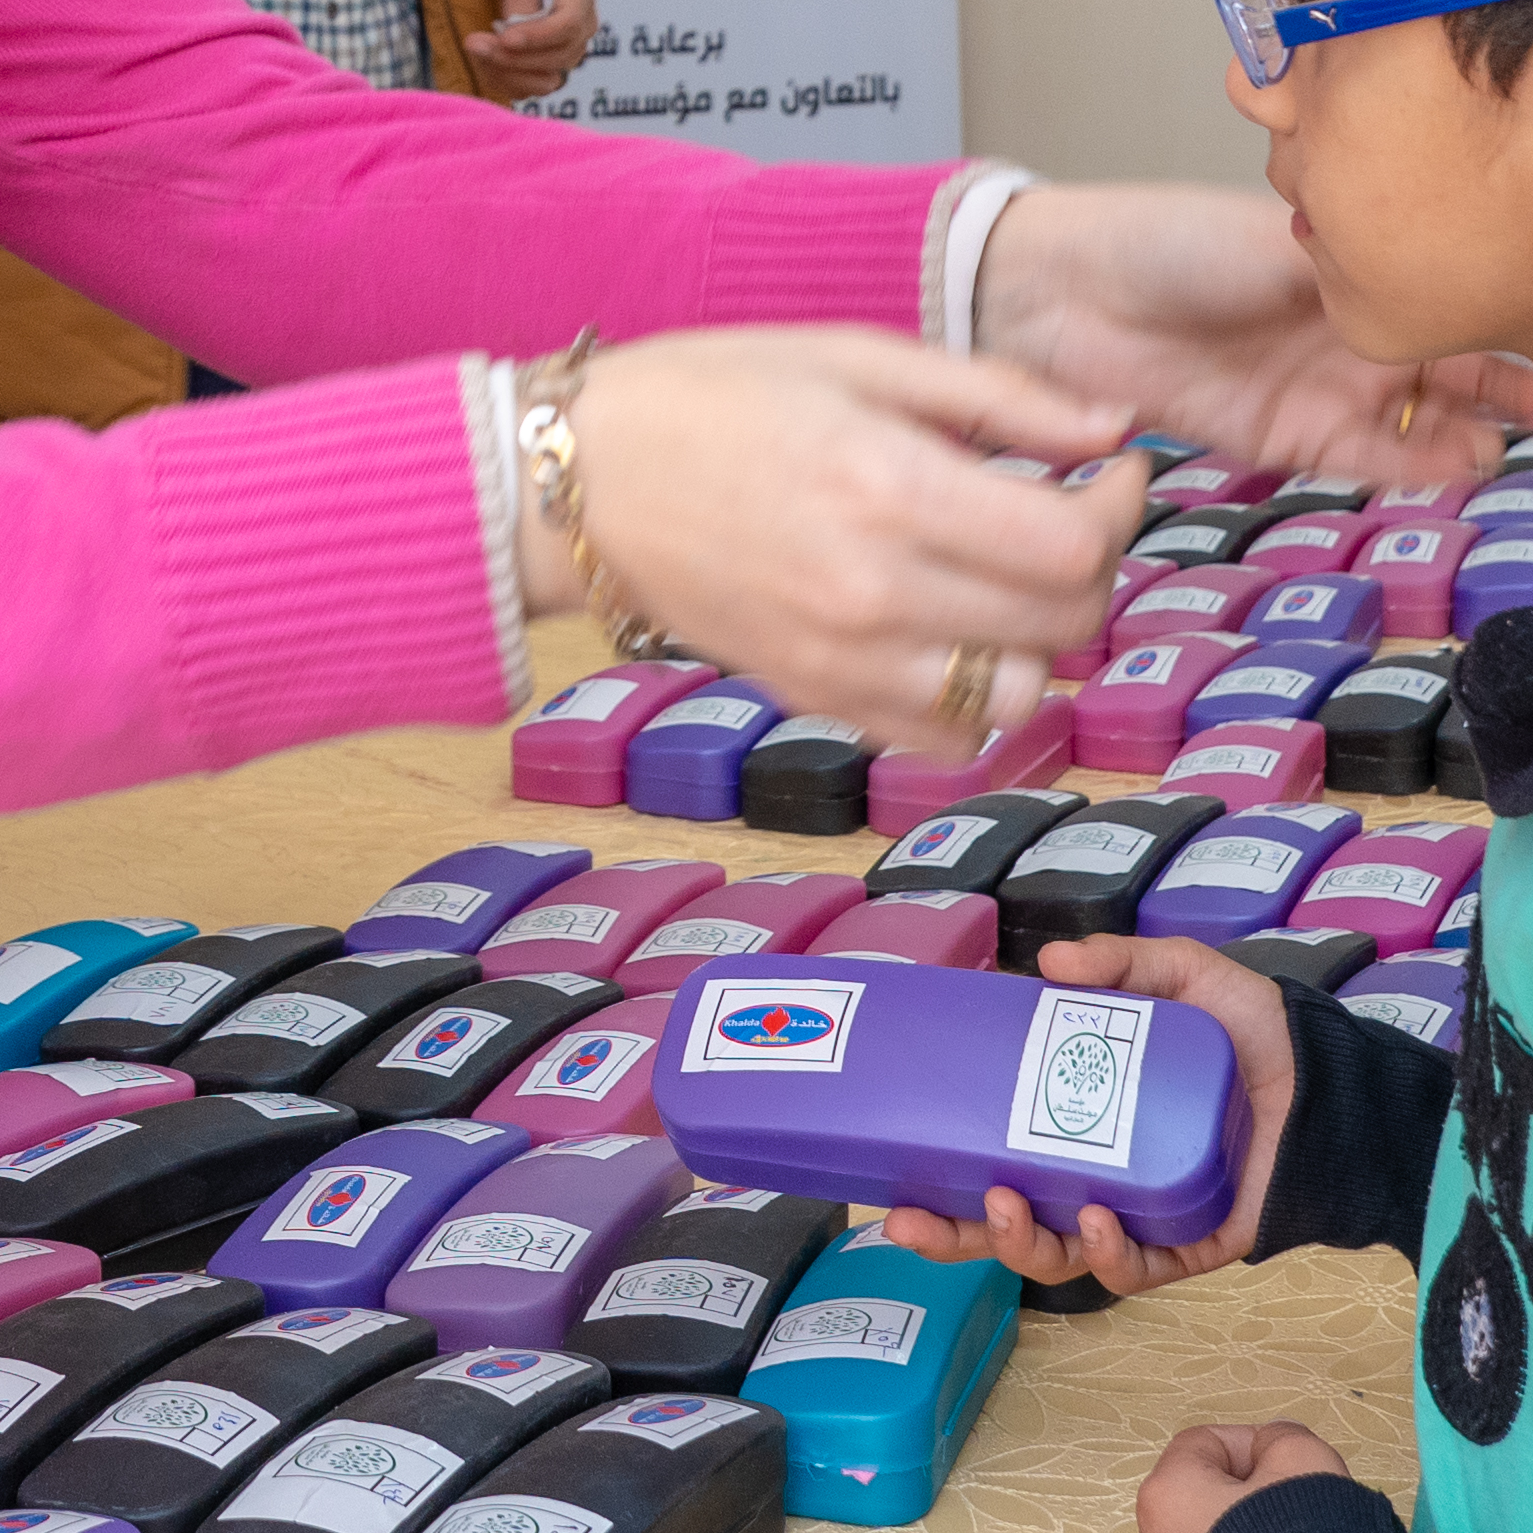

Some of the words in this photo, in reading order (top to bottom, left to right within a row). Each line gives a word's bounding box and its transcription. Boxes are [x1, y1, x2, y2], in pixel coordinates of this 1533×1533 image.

[630, 23, 725, 65] برعاية
[590, 80, 714, 124] مؤسسة
[724, 86, 768, 124] مع
[780, 72, 901, 117] بالتعاون
[723, 1019, 760, 1029] Khalda
